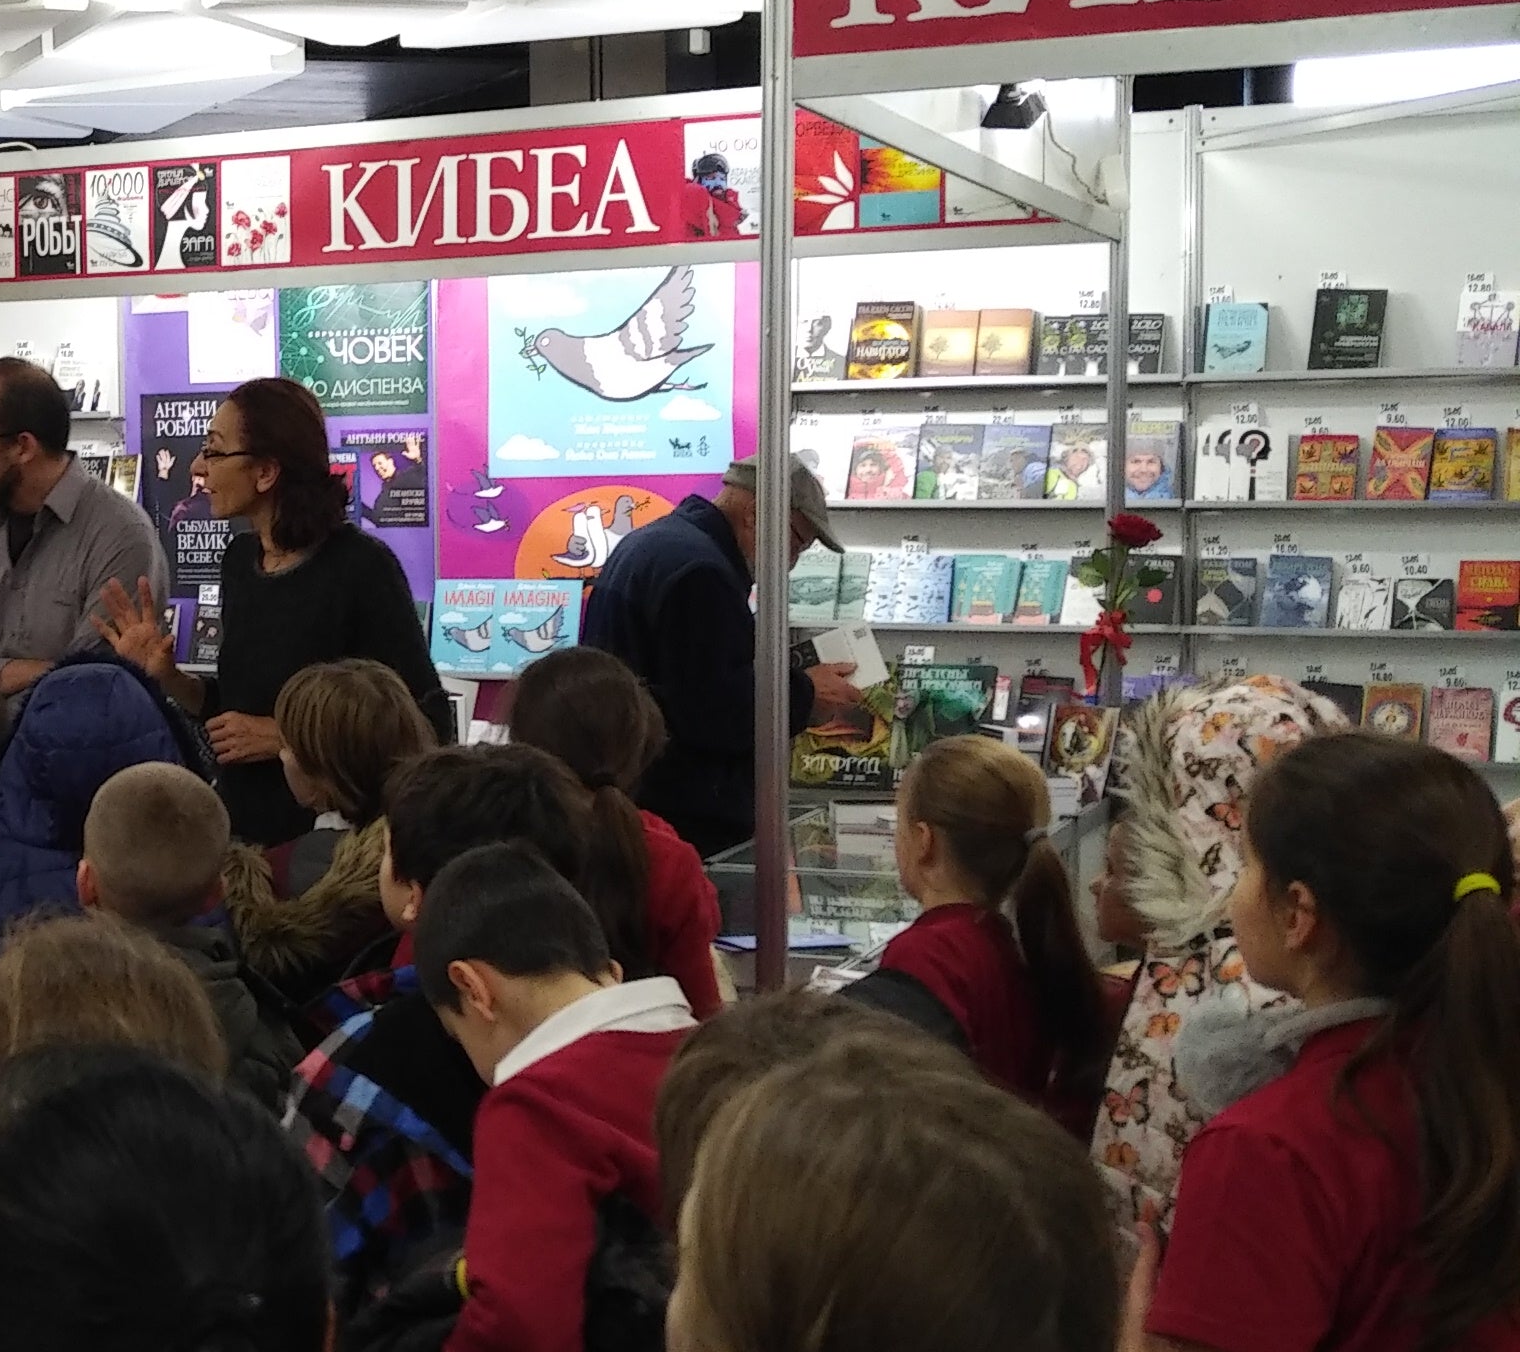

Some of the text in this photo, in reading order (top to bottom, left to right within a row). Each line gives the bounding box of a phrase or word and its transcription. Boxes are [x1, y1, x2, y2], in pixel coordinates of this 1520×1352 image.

[322, 138, 661, 253] КИБЕА
[182, 235, 215, 252] ЗАРА
[1468, 284, 1491, 292] 12.80
[1079, 300, 1100, 308] 12.80
[328, 334, 424, 365] ЧОВЕК
[331, 377, 425, 399] ДИСПЕНЗА
[154, 400, 218, 418] АНТЪНИ
[1235, 414, 1257, 423] 12.00
[346, 433, 386, 444] АНТЪНИ
[177, 520, 230, 532] СЪБУДЕТЕ
[1206, 546, 1228, 555] 11.20
[177, 552, 186, 564] В
[186, 551, 212, 564] СЕБЕ
[1352, 564, 1370, 573] 9.60
[1405, 565, 1428, 575] 10.40
[504, 590, 570, 607] IMAGINE
